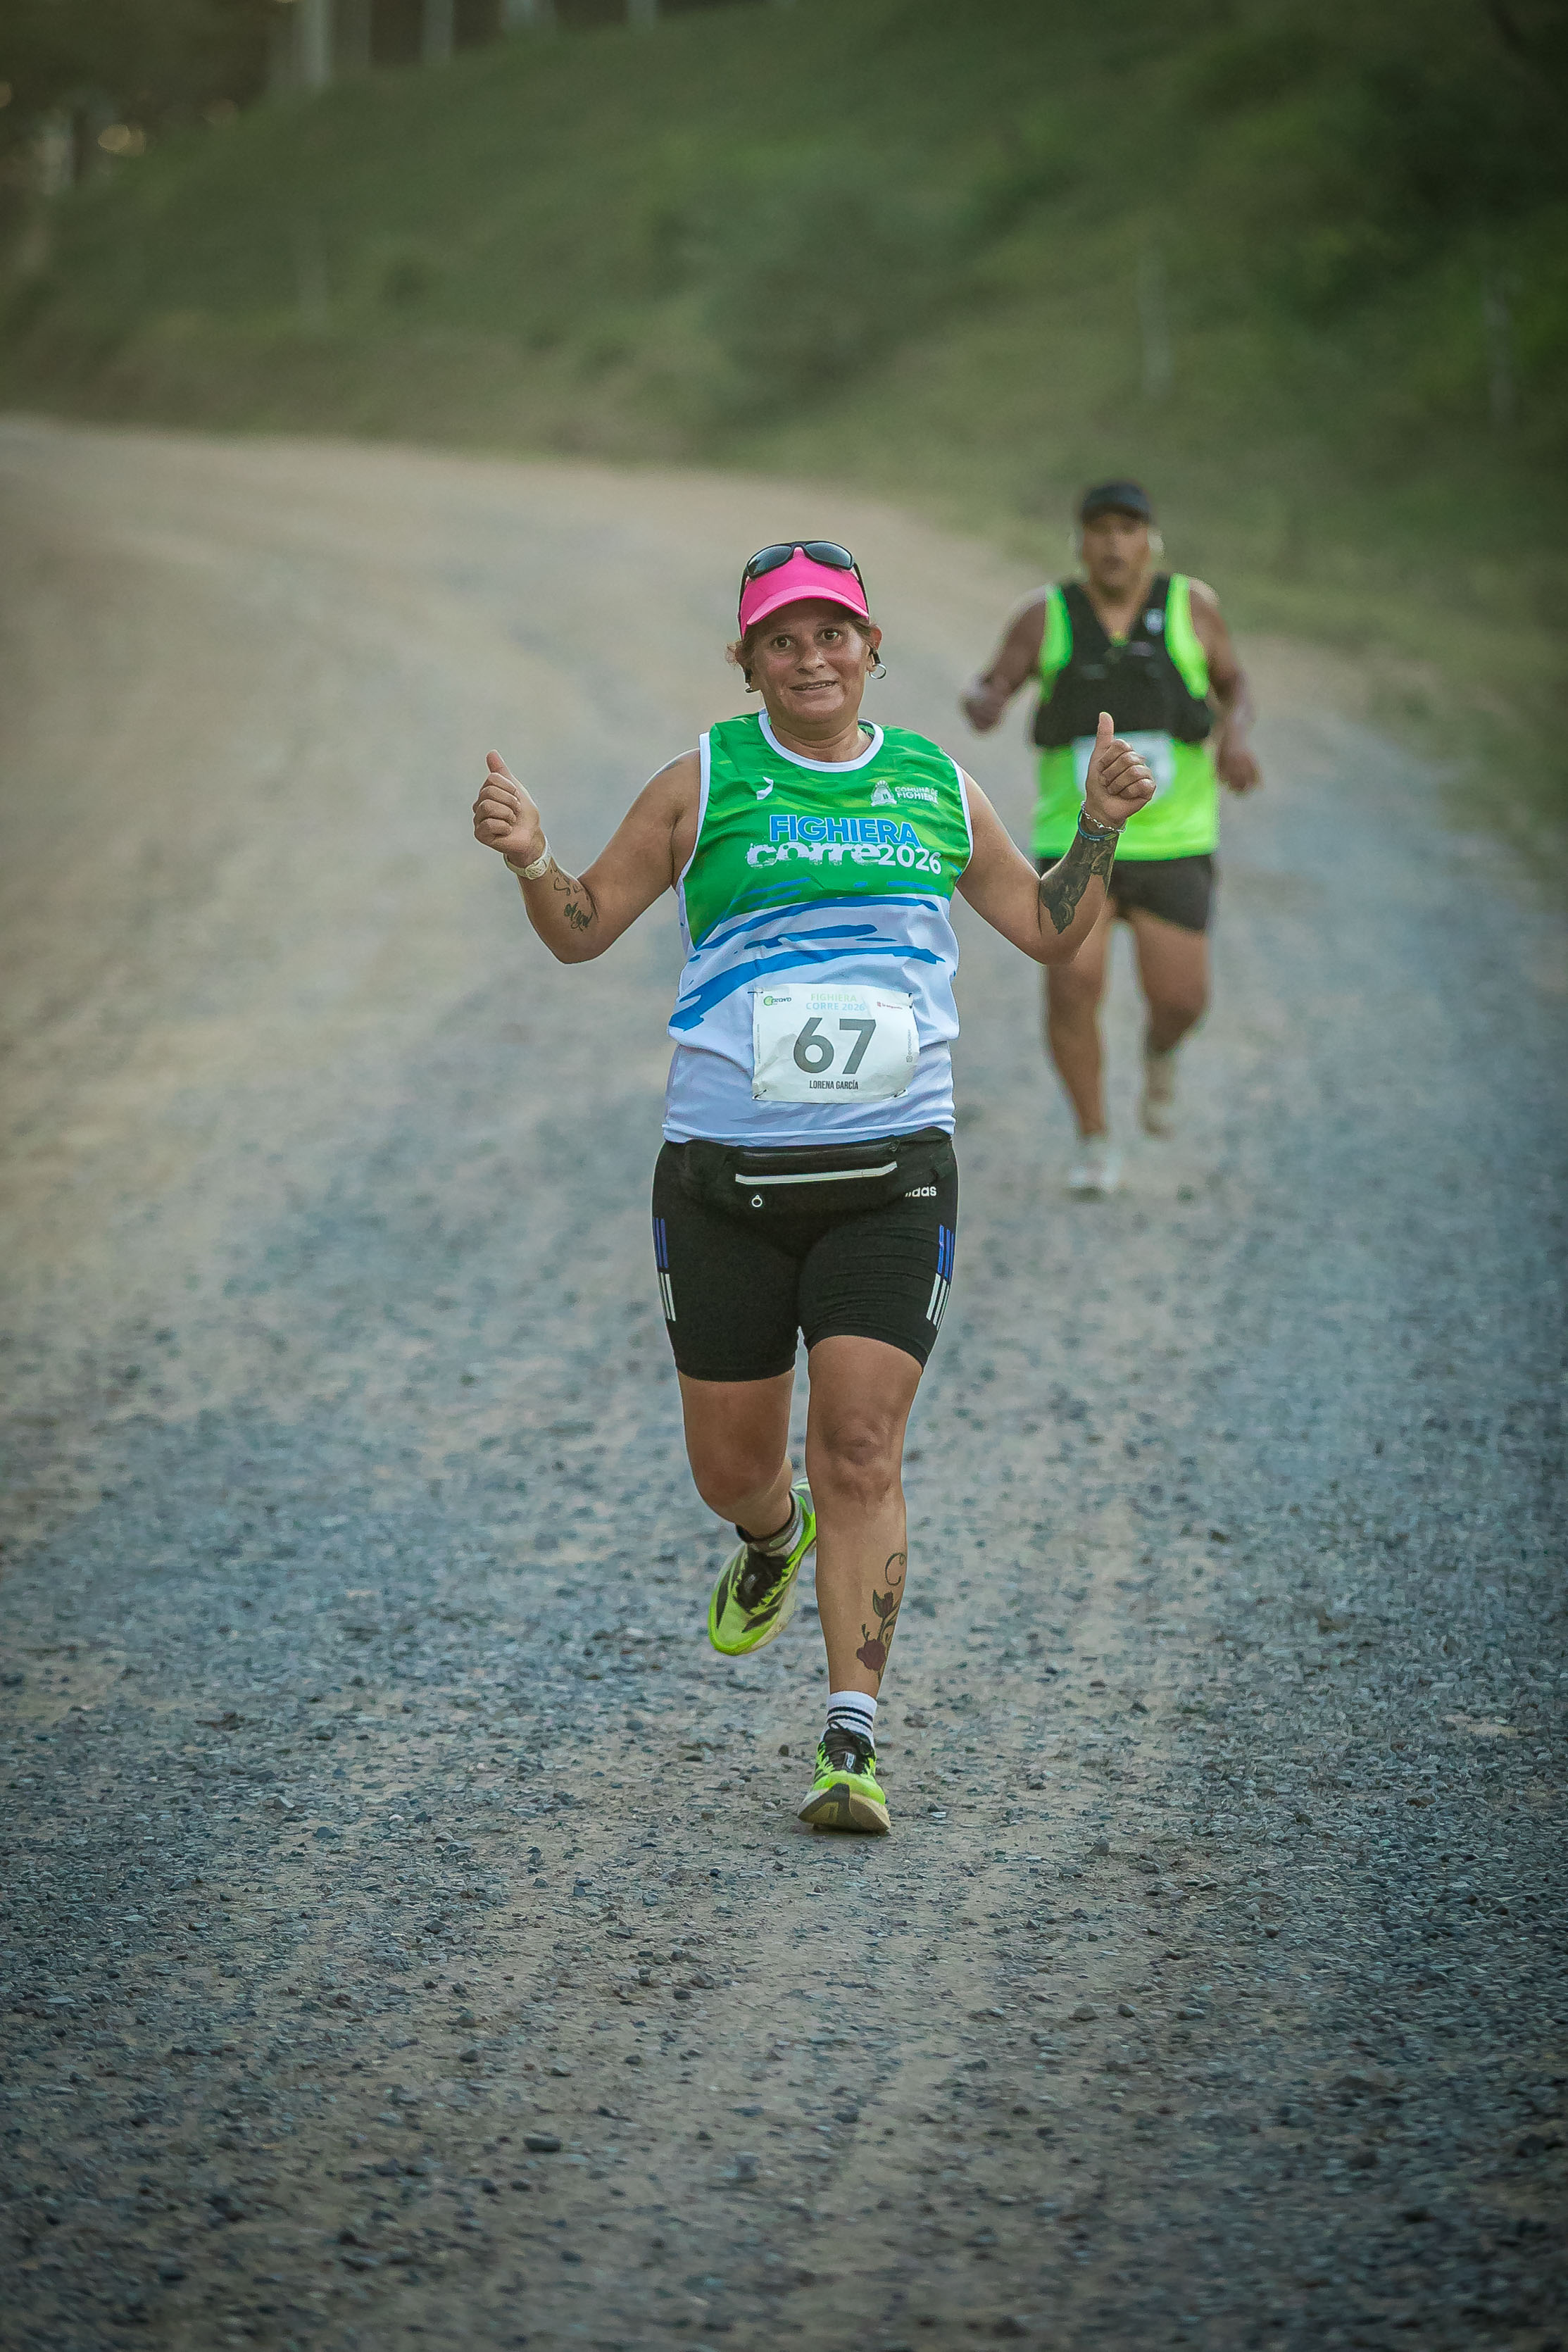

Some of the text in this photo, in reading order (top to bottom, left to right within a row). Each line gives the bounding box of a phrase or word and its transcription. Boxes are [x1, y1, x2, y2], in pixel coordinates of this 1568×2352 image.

[930, 788, 939, 796] DE
[897, 792, 939, 804] FIGHIERA
[769, 814, 921, 848] FIGHIERA
[810, 993, 857, 1002] FIGHIERA
[805, 1002, 865, 1011] CORRE 2026
[794, 1017, 877, 1075] 67
[809, 1080, 858, 1090] LORENA GARCÍA
